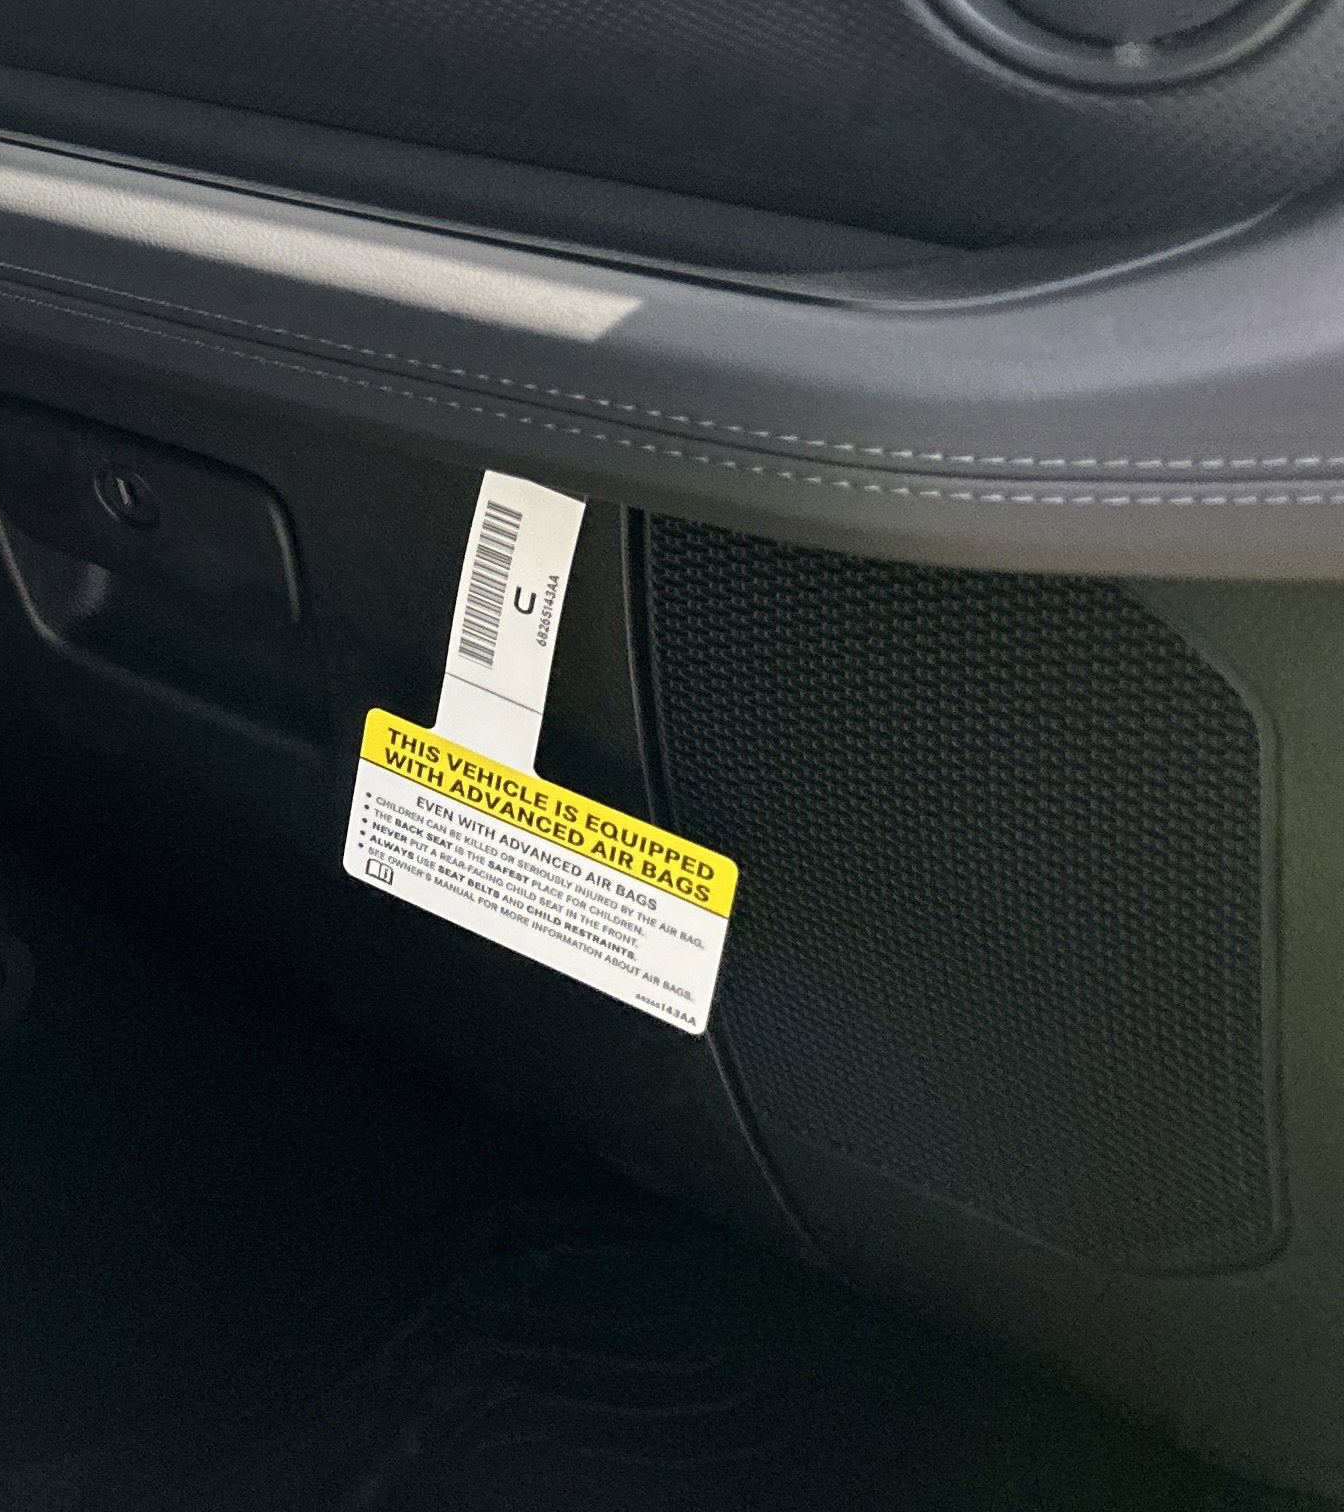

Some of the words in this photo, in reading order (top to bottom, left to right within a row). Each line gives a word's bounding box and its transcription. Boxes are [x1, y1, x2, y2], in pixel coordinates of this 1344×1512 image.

[514, 586, 537, 615] U
[373, 808, 392, 823] THE
[394, 817, 423, 837] BACK
[426, 831, 452, 850] SEAT
[454, 844, 464, 856] IS
[466, 849, 485, 865] THE
[487, 859, 529, 885] SAFEST
[531, 878, 563, 900] PLACE
[565, 894, 586, 910] FOR
[382, 747, 444, 787] WITH
[448, 776, 585, 848] ADVANCED
[590, 837, 634, 870] AIR
[640, 859, 711, 903] BAGS
[386, 726, 441, 764] THIS
[444, 752, 549, 811] VEHICLE
[554, 798, 579, 824] IS
[584, 812, 716, 882] EQUIPPED
[416, 795, 454, 822] EVEN
[457, 814, 495, 840] WITH
[498, 832, 582, 878] ADVANCED
[585, 870, 612, 891] AIR
[615, 883, 658, 911] BAGS
[367, 845, 385, 861] SEE
[434, 876, 476, 902] MANUAL
[478, 896, 497, 912] FOR
[499, 906, 529, 926] MORE
[531, 921, 602, 959] INFORMATION
[604, 953, 639, 976] ABOUT
[642, 971, 660, 986] AIR
[369, 833, 414, 860] ALWAYS
[416, 854, 435, 870] USE
[437, 864, 465, 883] SEAT
[467, 878, 500, 899] BELTS
[502, 893, 524, 910] AND
[526, 904, 561, 927] CHILD
[371, 821, 408, 844] NEVER
[409, 838, 428, 853] PUT
[430, 847, 437, 857] A
[505, 881, 537, 902] CHILD
[538, 896, 563, 914] SEAT
[565, 908, 577, 920] IN
[579, 914, 600, 931] THE
[375, 795, 424, 824] CHILDREN
[426, 818, 447, 834] CAN
[449, 828, 461, 841] BE
[464, 835, 498, 857] KILLED
[500, 851, 515, 864] OR
[516, 858, 572, 890] SERIOUSLY
[574, 884, 618, 910] INJURED
[620, 904, 634, 917] BY
[635, 911, 657, 928] THE
[658, 921, 677, 937] AIR
